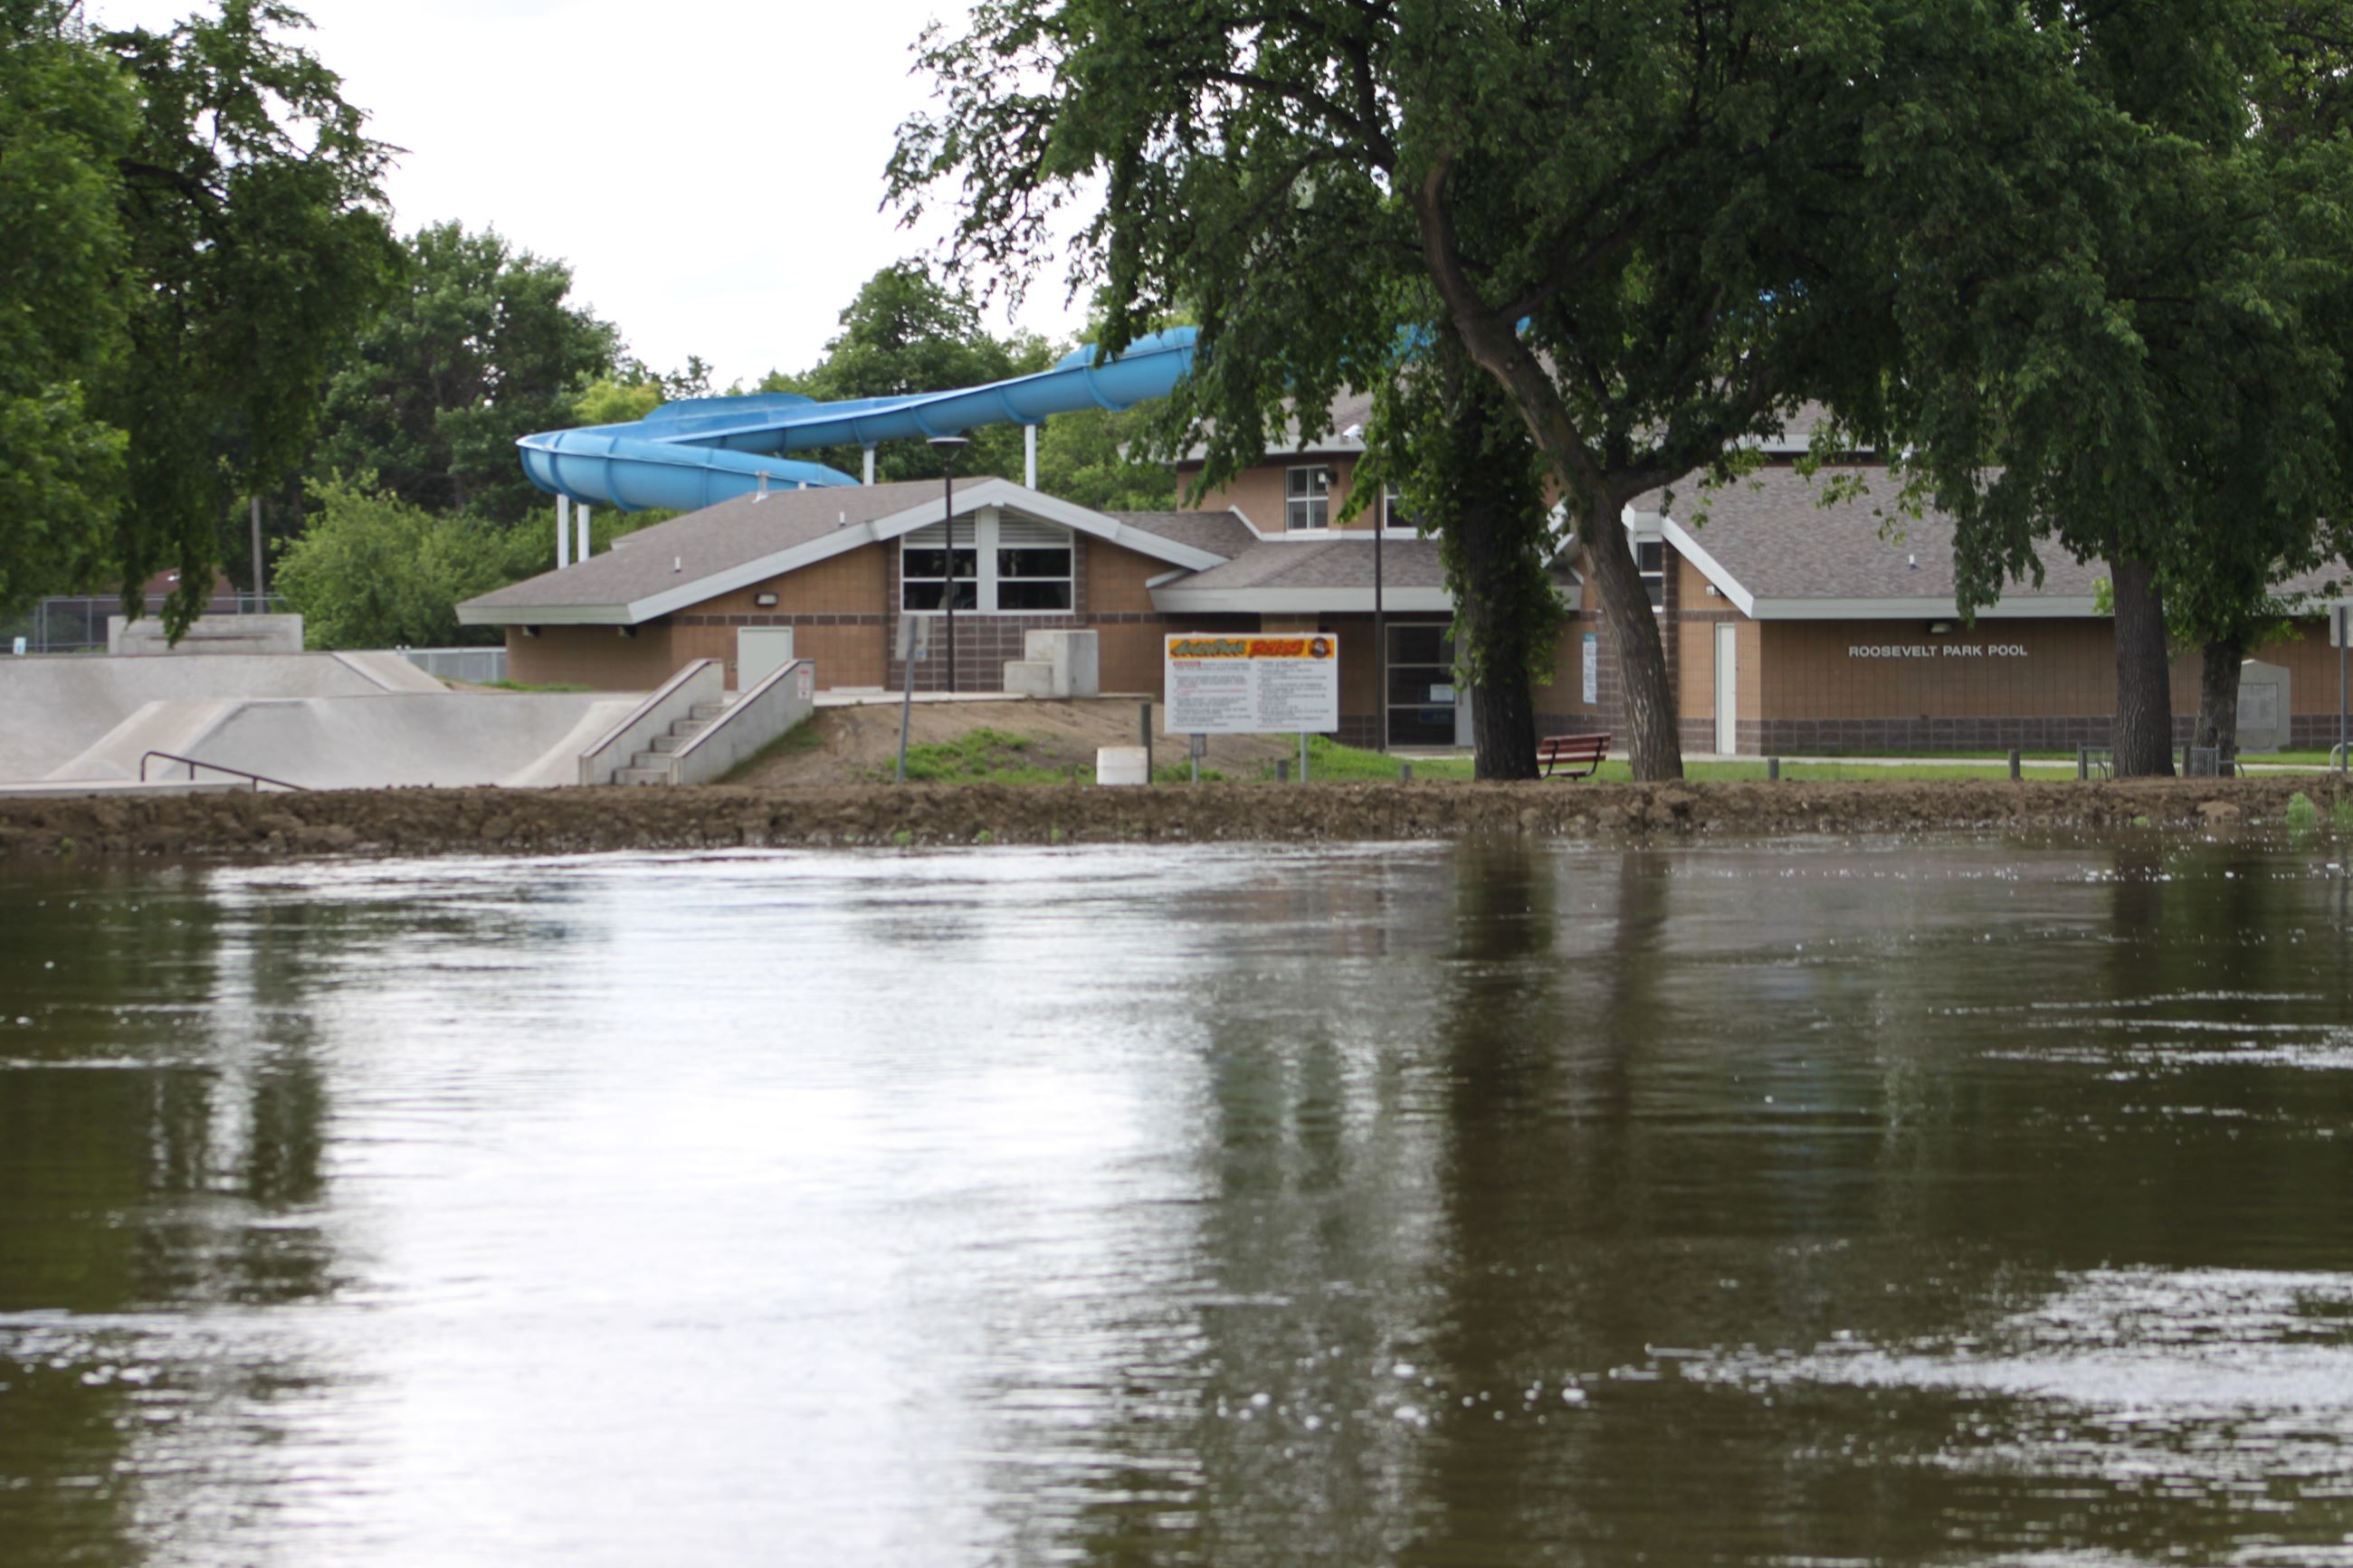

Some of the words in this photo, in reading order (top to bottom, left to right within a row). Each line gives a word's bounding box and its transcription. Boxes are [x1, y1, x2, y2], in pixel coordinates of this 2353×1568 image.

[1849, 645, 1937, 657] ROOSEVELT
[1943, 645, 1983, 657] PARK
[1988, 644, 2027, 656] POOL
